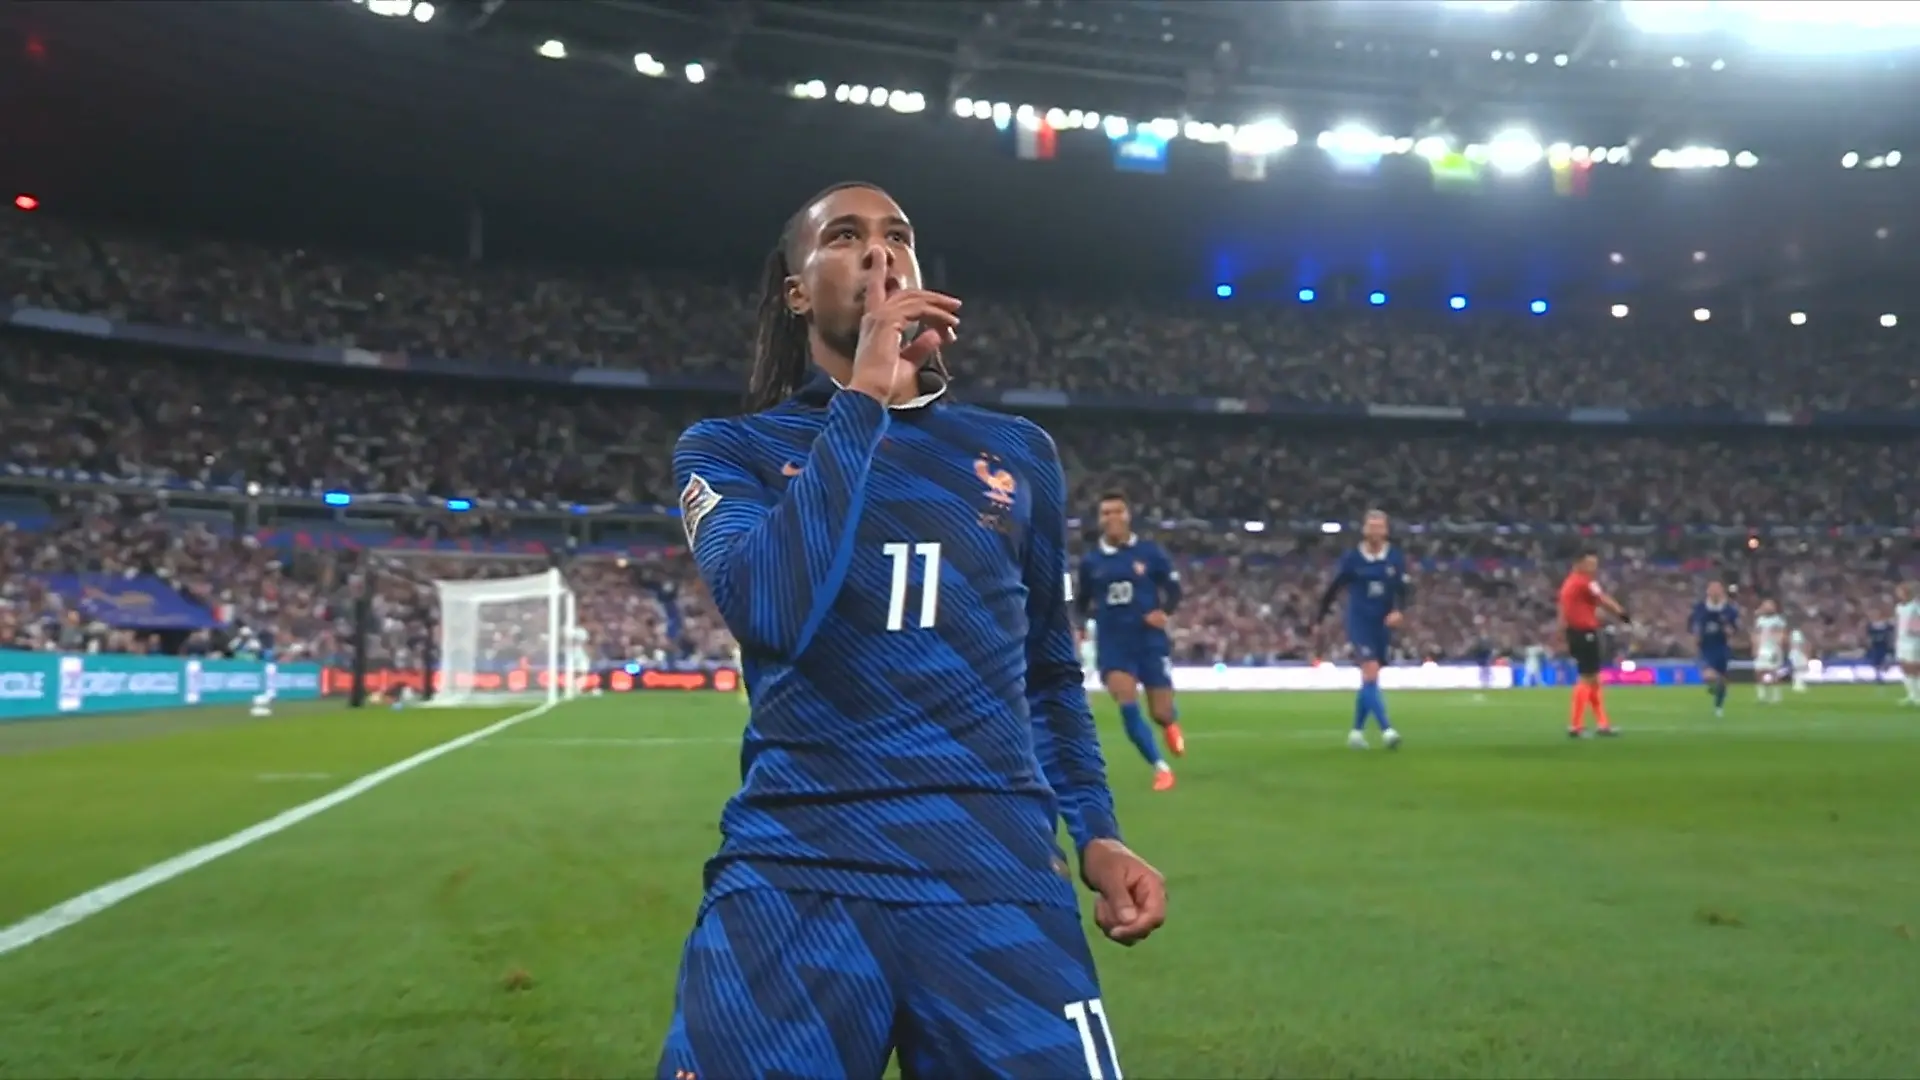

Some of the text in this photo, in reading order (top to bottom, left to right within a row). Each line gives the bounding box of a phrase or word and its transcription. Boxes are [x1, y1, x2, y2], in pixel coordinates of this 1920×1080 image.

[883, 542, 941, 632] 11
[1107, 580, 1133, 605] 20
[1063, 998, 1123, 1080] 11
